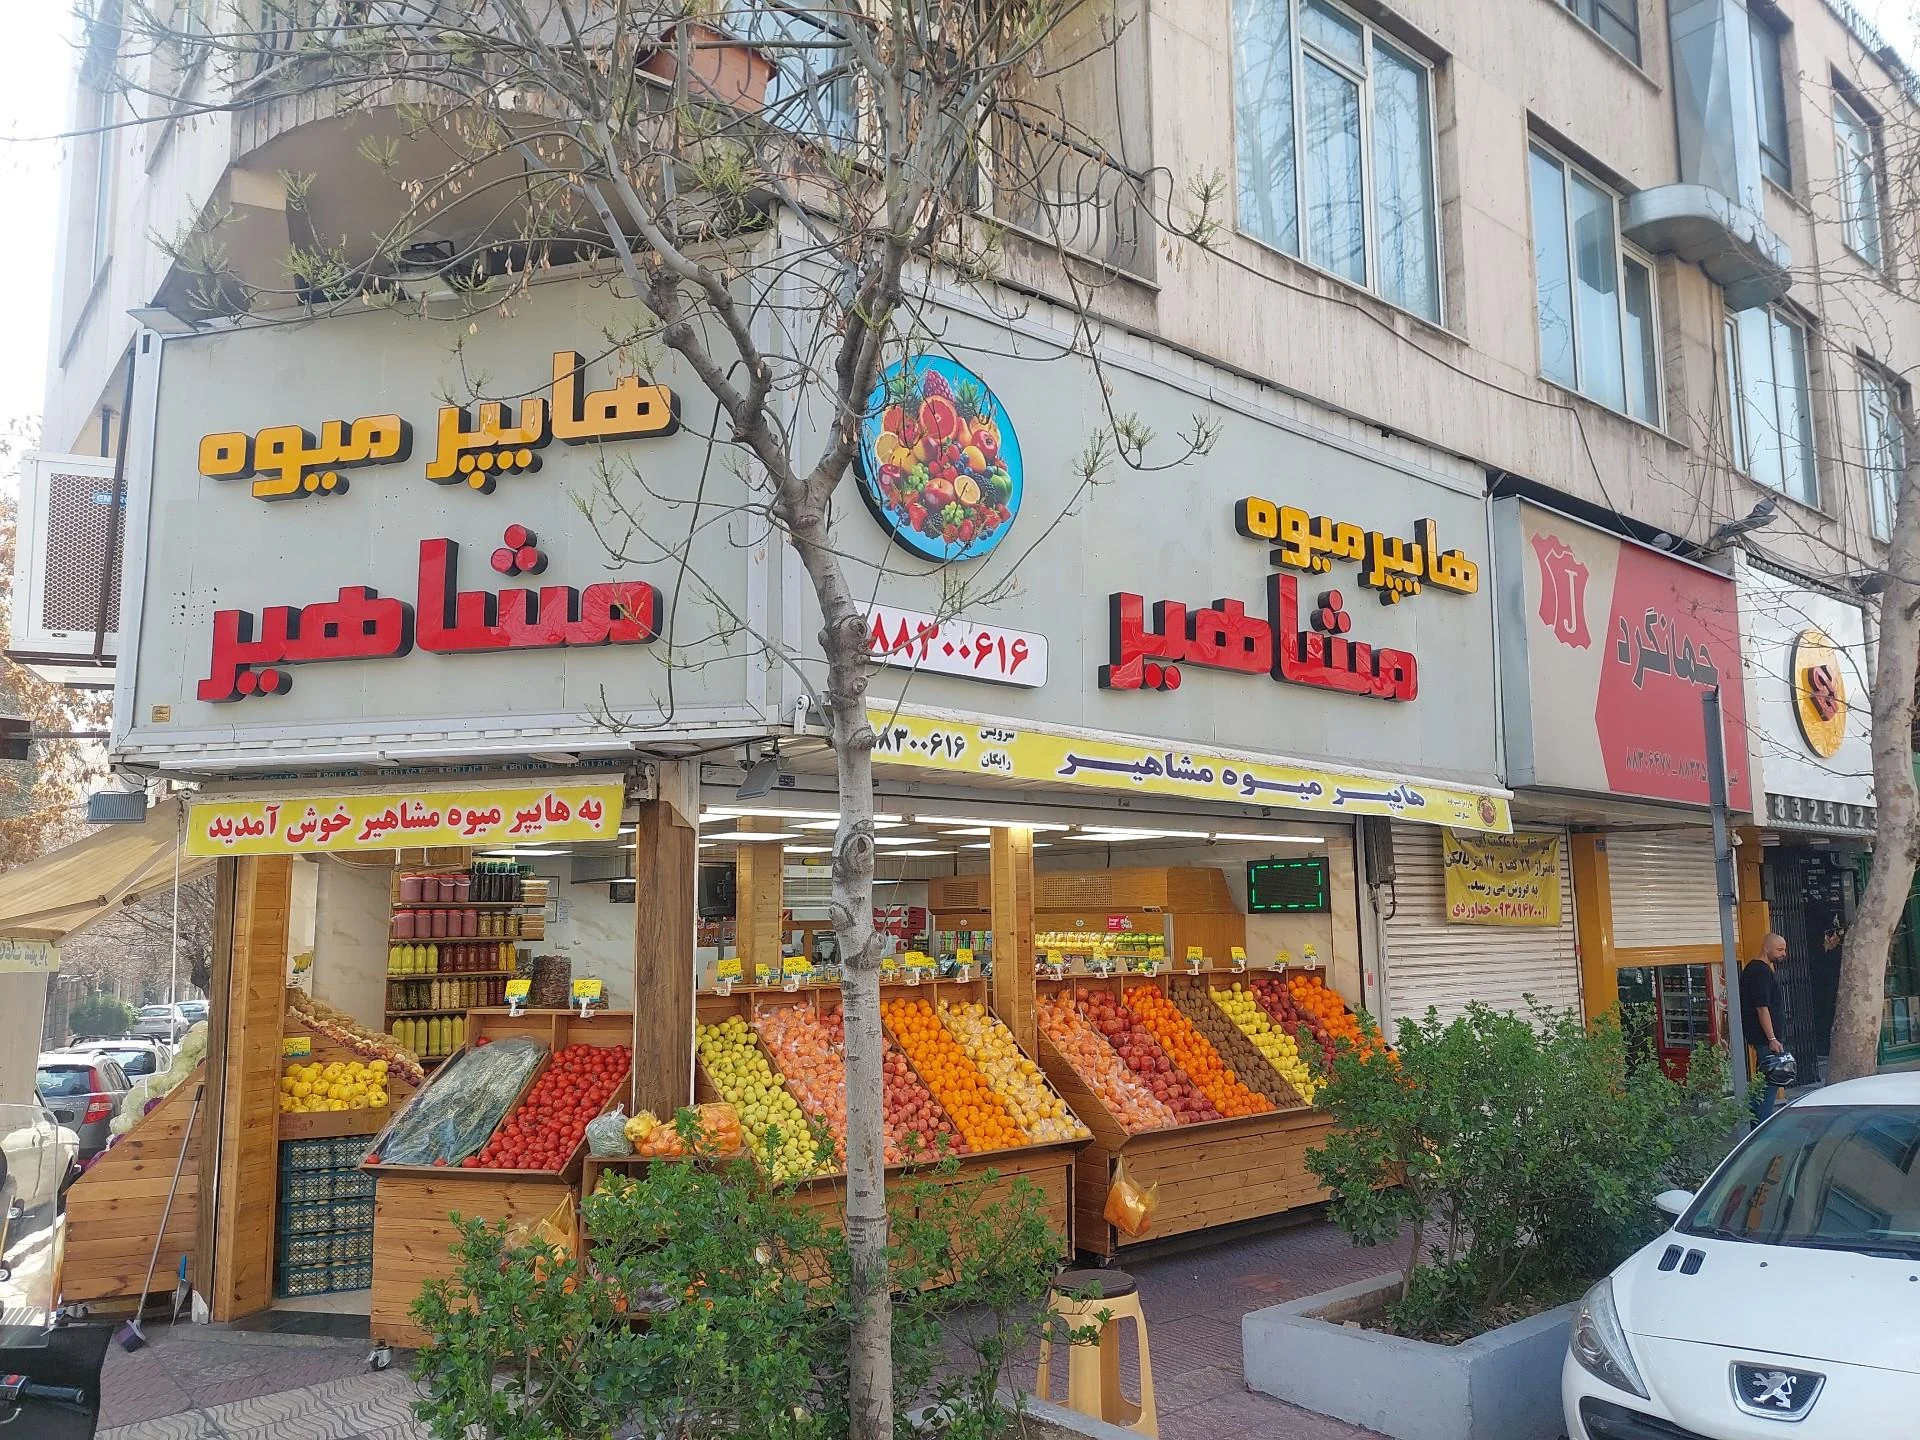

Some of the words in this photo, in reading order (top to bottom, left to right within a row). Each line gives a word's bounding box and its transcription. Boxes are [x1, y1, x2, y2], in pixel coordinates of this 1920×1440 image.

[426, 351, 681, 495] هایپر
[198, 412, 412, 501] میوه
[1234, 496, 1367, 572] میوه
[1357, 518, 1479, 606] هایپر
[197, 523, 663, 702] مشاهیر
[1099, 573, 1418, 701] مشاهیر
[871, 727, 965, 758] ۸۳۰۰۶۱۶
[981, 728, 1015, 742] سرویس
[982, 753, 1011, 770] رایگان
[1058, 753, 1213, 782] مشاهیر
[1222, 770, 1322, 799] میوه
[1332, 784, 1425, 810] هایپر
[209, 805, 280, 845] آمدید
[287, 805, 351, 843] خوش
[359, 801, 440, 841] مشاهیر
[448, 806, 501, 836] میوه
[510, 794, 570, 834] هایپر
[578, 797, 602, 829] به
